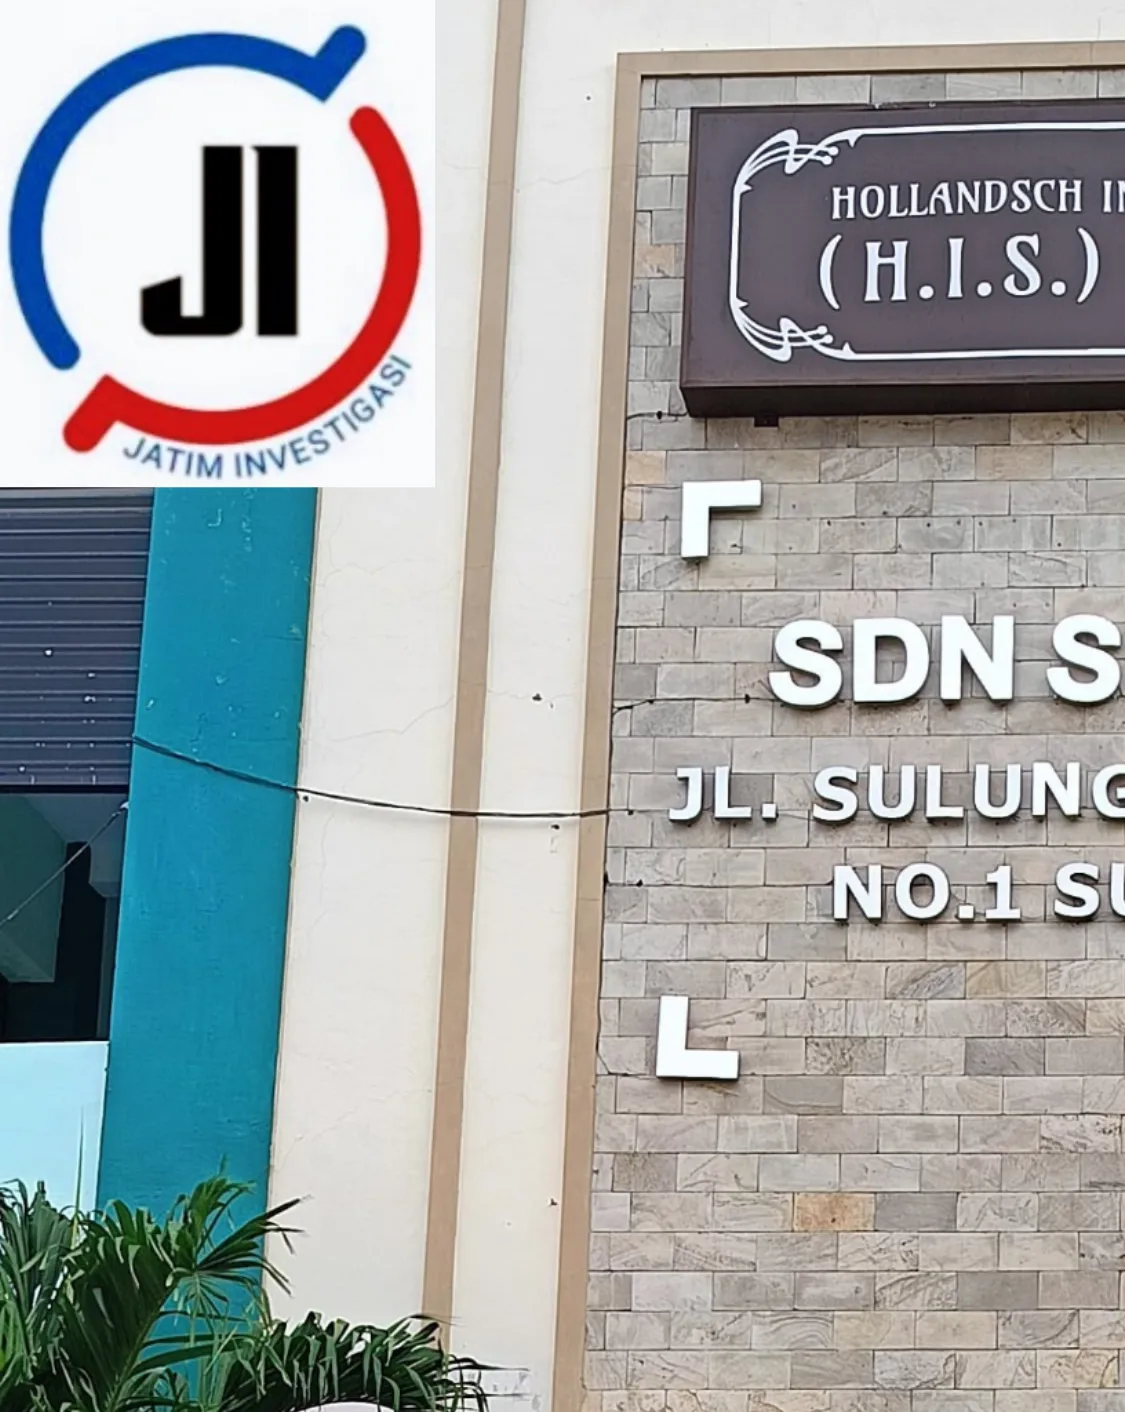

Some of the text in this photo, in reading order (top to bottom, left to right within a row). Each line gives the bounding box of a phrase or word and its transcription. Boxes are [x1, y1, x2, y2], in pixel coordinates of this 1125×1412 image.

[831, 178, 1083, 221] HOLLANDSCH
[768, 614, 1015, 706] SDN
[669, 765, 778, 822] JL.
[833, 862, 1021, 920] NO.1
